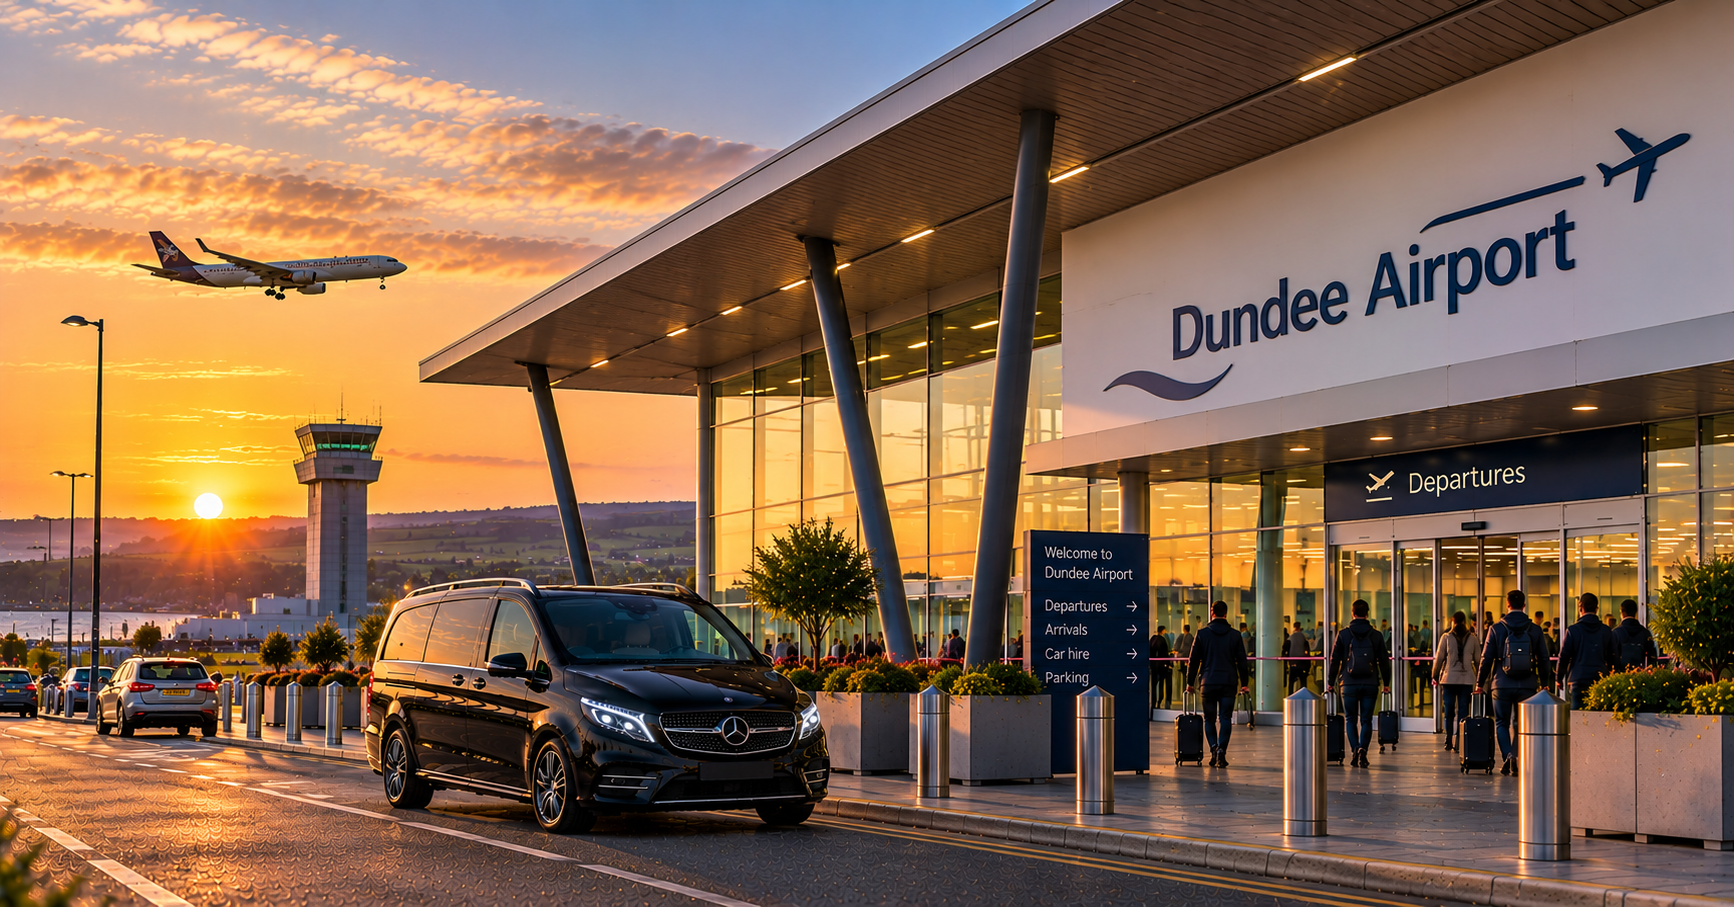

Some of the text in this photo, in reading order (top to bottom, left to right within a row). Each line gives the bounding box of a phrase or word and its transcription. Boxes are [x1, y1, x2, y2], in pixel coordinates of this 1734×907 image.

[1172, 209, 1576, 361] Dundee Airport
[1409, 465, 1526, 497] Departures
[1044, 546, 1113, 560] Welcome to
[1045, 565, 1133, 582] Dundee Airport
[1045, 599, 1108, 614] Departures
[1044, 623, 1088, 636] Arrivals
[1045, 647, 1090, 660] Car hire
[1045, 671, 1090, 687] Parking
